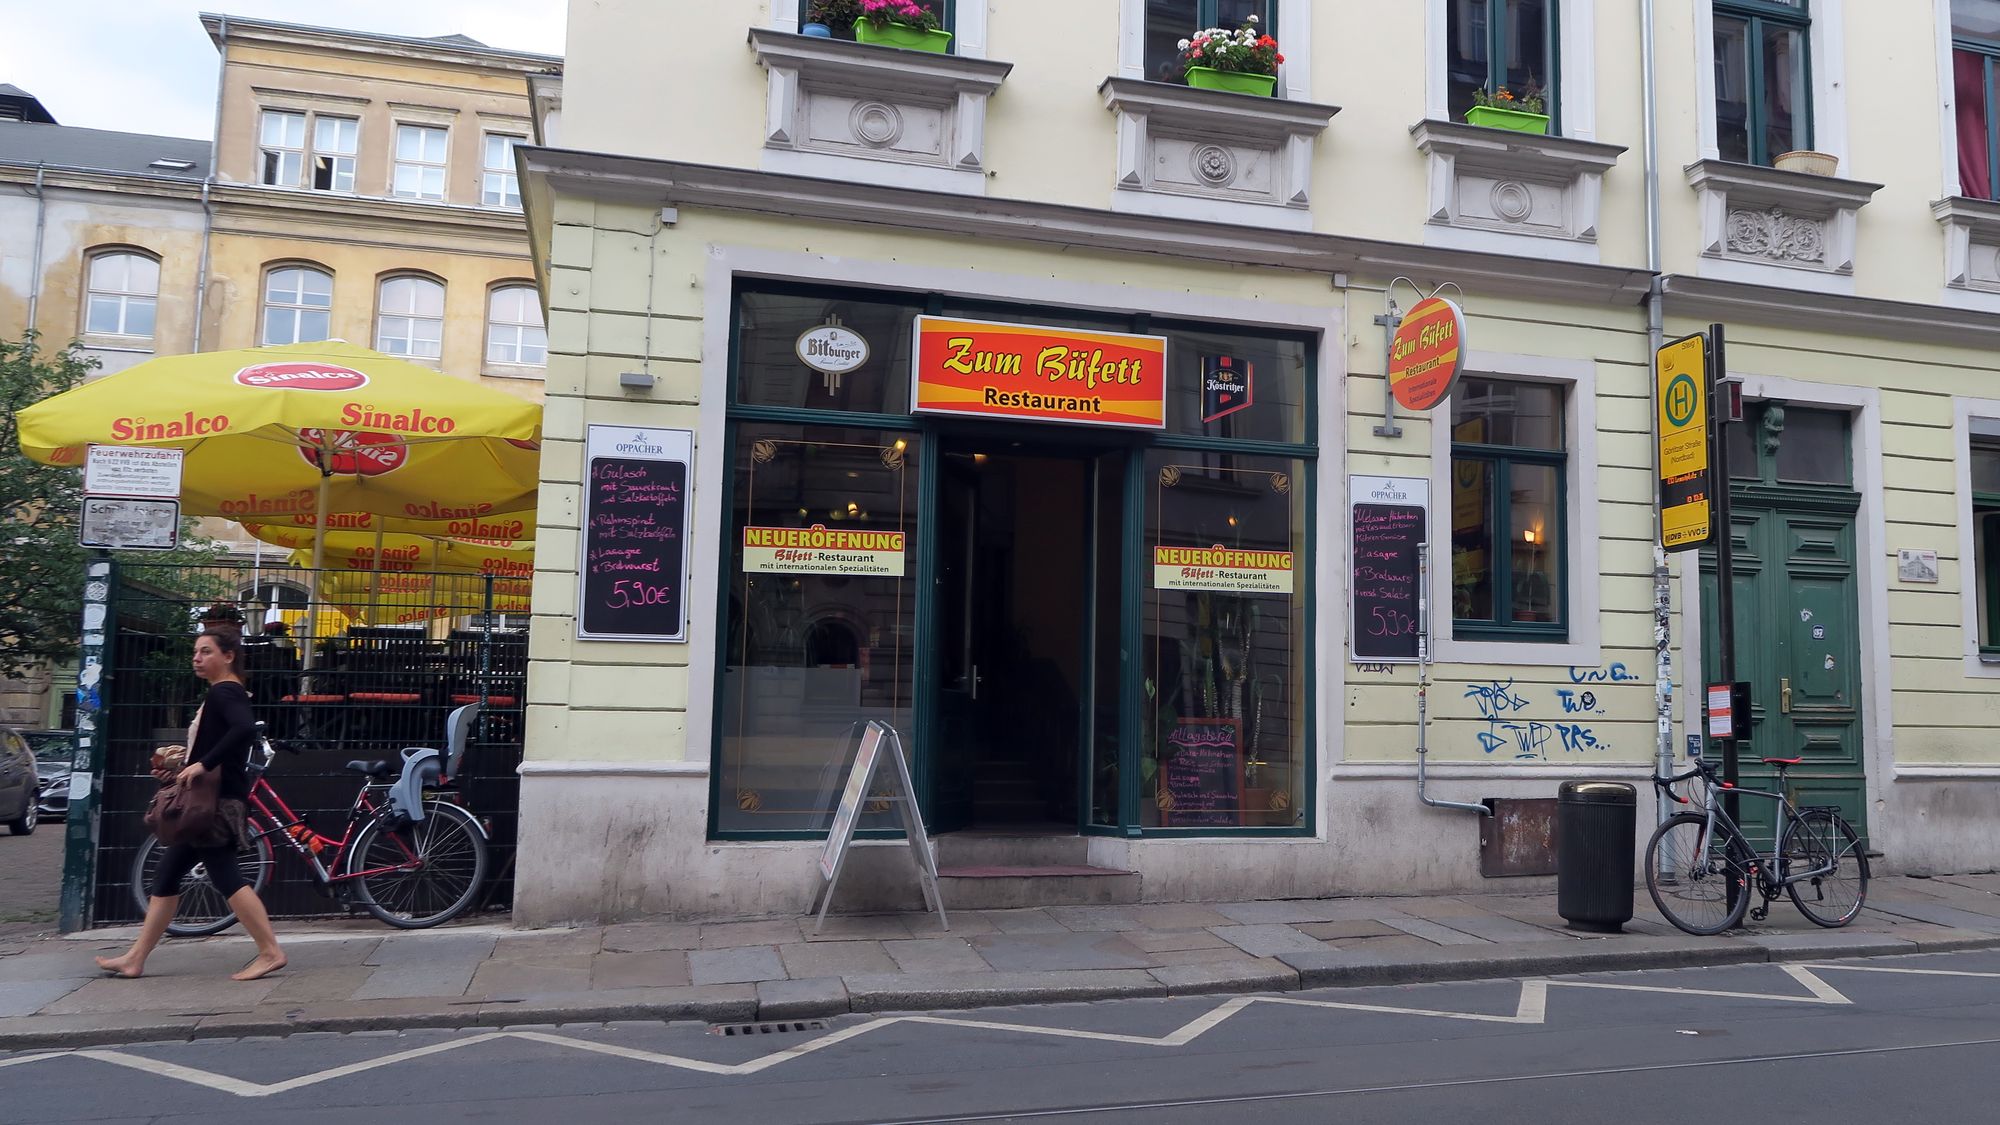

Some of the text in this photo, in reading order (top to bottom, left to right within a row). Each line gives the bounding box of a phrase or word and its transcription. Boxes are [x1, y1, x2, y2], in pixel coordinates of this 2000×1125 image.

[806, 338, 860, 360] Bitburger
[1393, 319, 1455, 361] Zum Büfett
[942, 337, 1143, 390] Zum Büfett
[1404, 355, 1441, 378] Restaurant
[247, 369, 356, 385] Sinalco
[983, 388, 1101, 413] Restaurant
[110, 411, 230, 441] Sinalco
[340, 402, 456, 434] Sinalco
[90, 447, 181, 460] Feuerwehrzufahrt
[616, 443, 664, 454] OPPACHER
[600, 463, 648, 479] Gulasch
[1371, 490, 1408, 500] OPPACHER
[746, 526, 904, 550] NEUERÖFFNUNG
[774, 548, 813, 564] Büfett
[1156, 546, 1292, 569] NEUERÖFFNUNG
[760, 562, 890, 573] mit internationalen Spezialitäten
[1181, 566, 1215, 580] Büfett
[1182, 580, 1236, 589] internationalen
[1236, 582, 1281, 590] Spezialitäten
[1367, 606, 1416, 637] 5,90€
